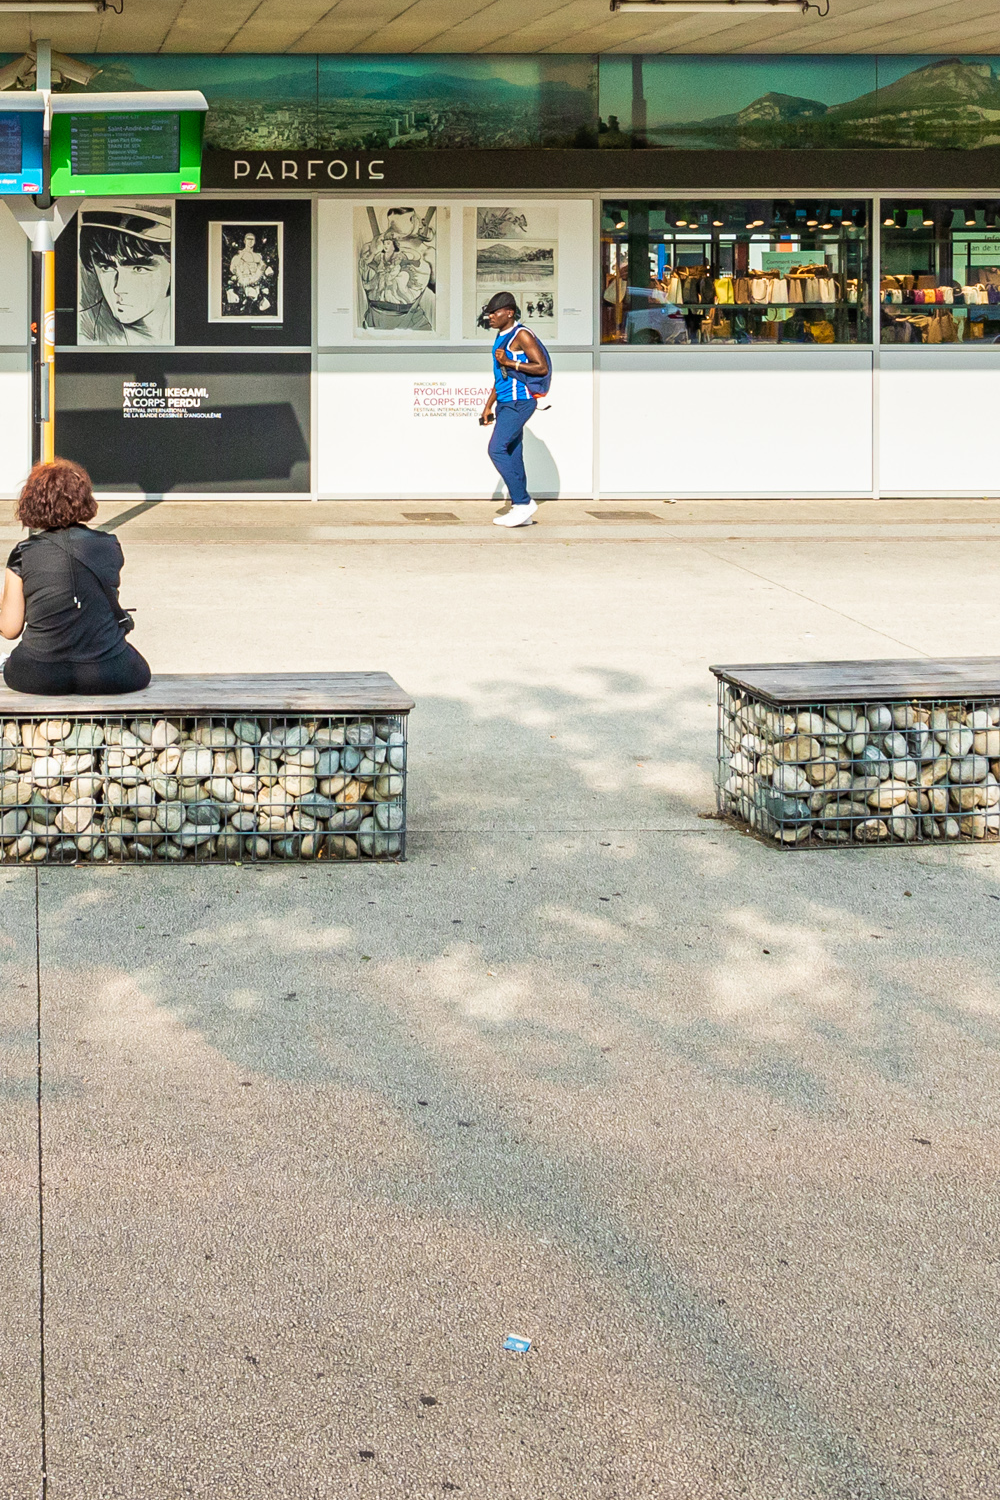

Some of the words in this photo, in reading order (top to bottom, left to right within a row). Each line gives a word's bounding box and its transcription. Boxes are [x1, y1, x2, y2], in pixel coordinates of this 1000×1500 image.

[234, 160, 384, 180] PARFOIS
[123, 388, 162, 397] RYOICHI
[165, 388, 209, 398] IKEGAMI,
[123, 397, 131, 407] À
[133, 398, 165, 407] CORPS
[168, 398, 201, 407] PERDU
[414, 397, 420, 406] À
